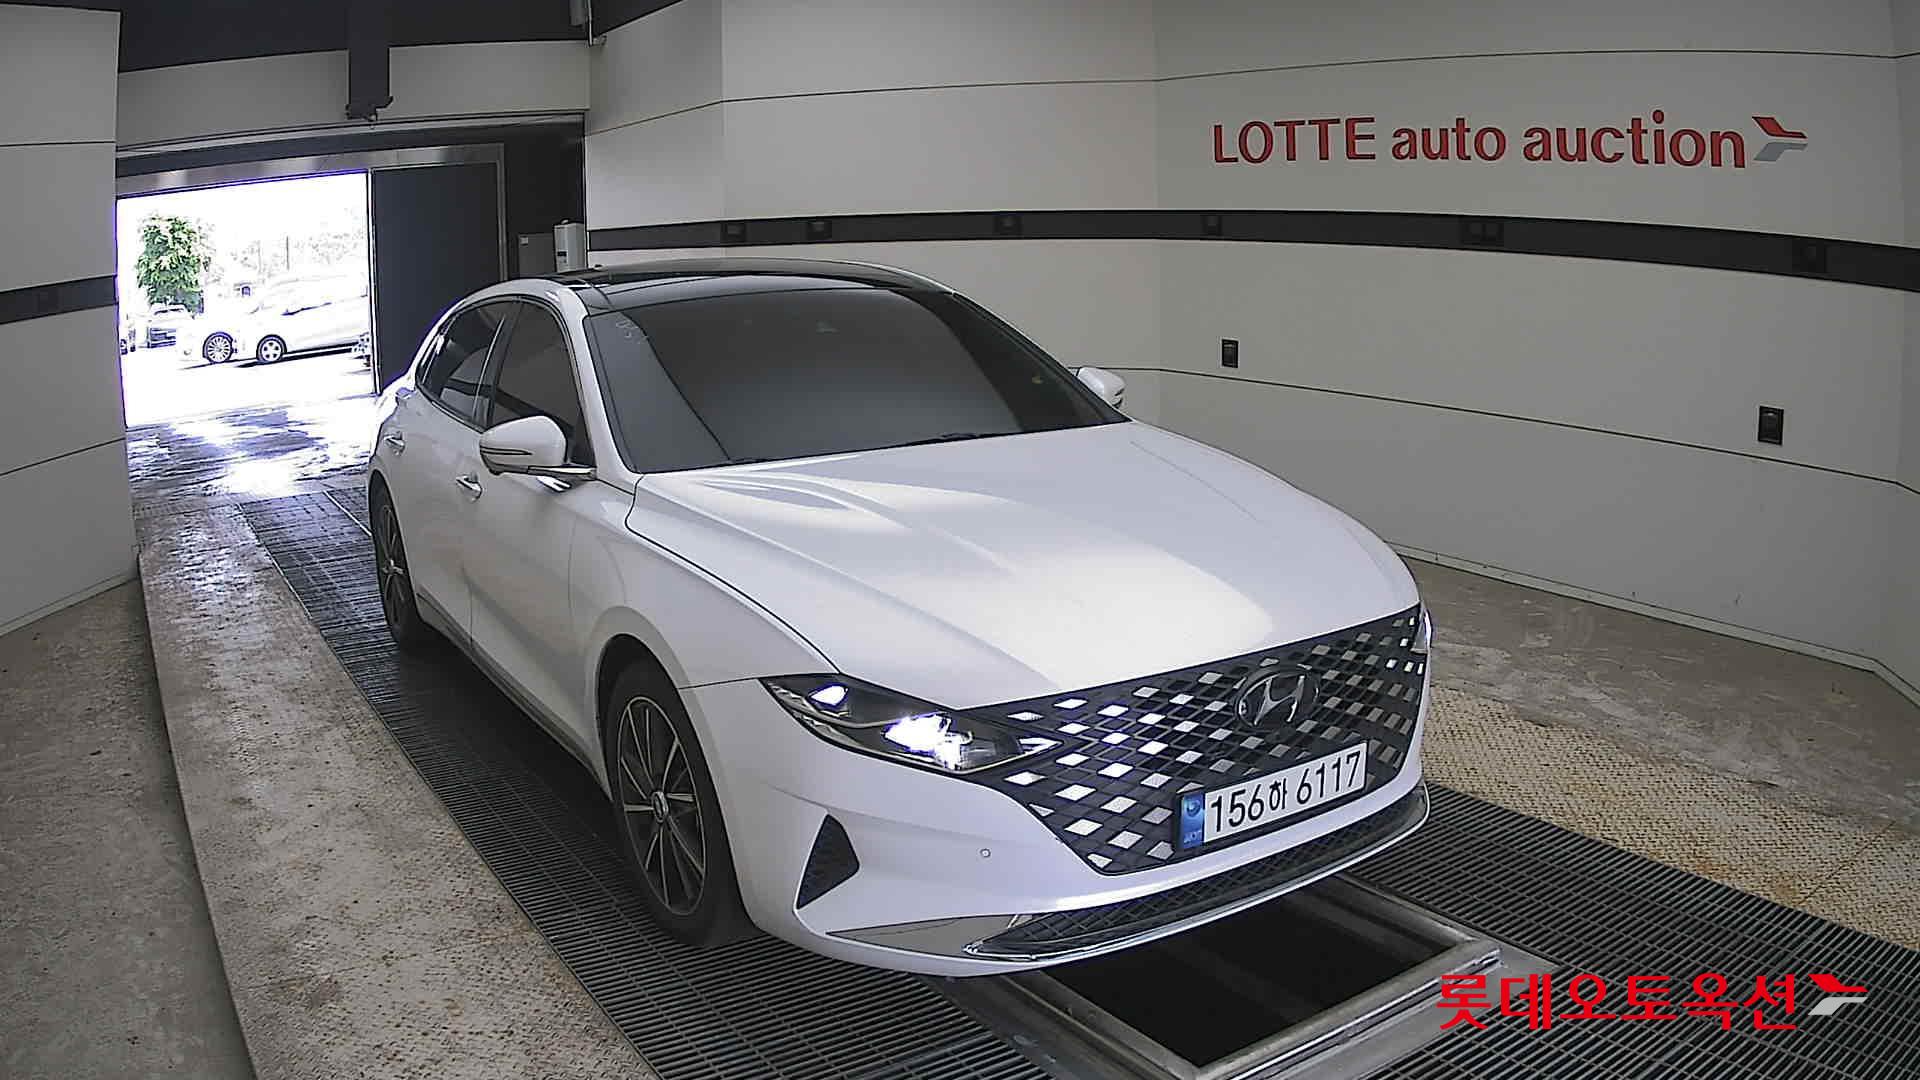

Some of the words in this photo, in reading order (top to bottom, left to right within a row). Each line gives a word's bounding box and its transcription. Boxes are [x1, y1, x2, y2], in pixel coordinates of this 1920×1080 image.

[1212, 117, 1376, 164] LOTTE
[1391, 117, 1507, 162] auto
[1522, 110, 1747, 168] auction
[1210, 777, 1288, 833] 156하
[1296, 750, 1361, 805] 6117
